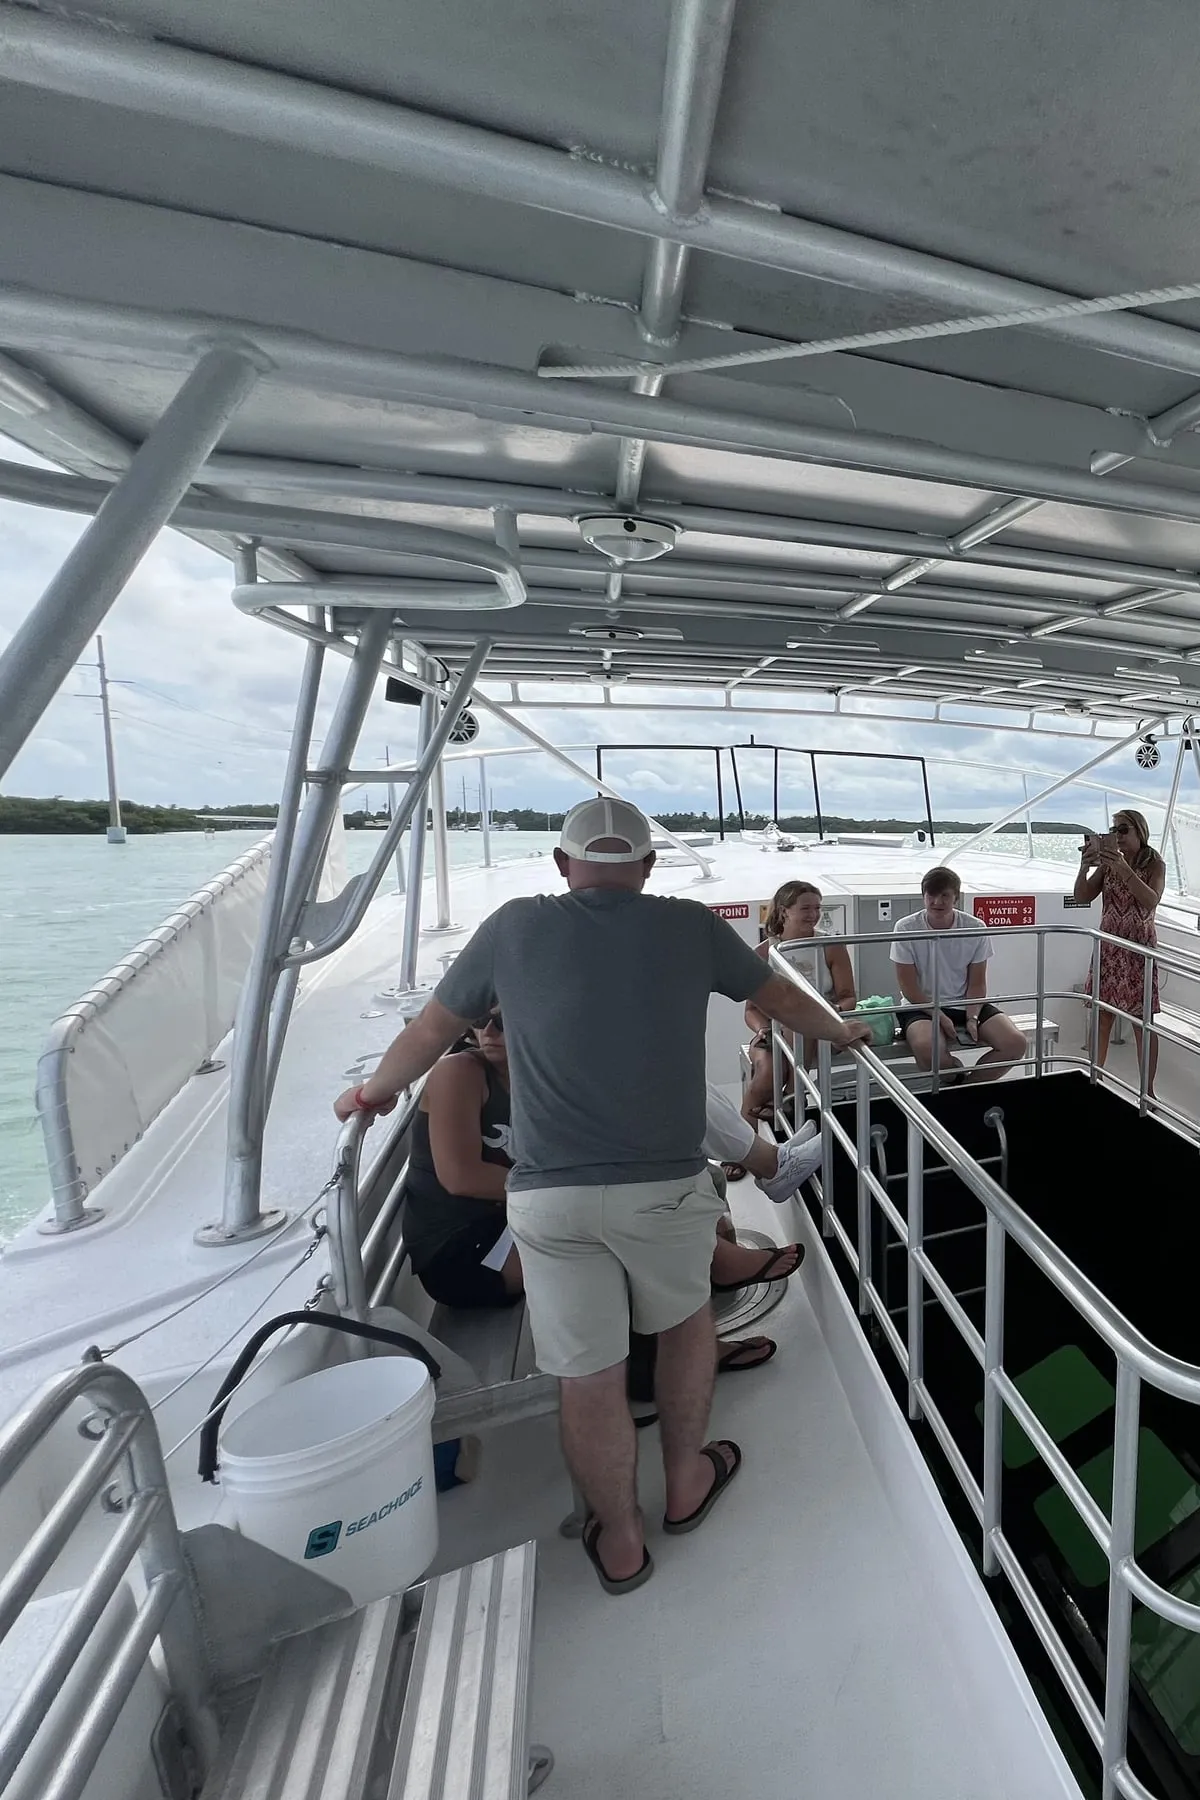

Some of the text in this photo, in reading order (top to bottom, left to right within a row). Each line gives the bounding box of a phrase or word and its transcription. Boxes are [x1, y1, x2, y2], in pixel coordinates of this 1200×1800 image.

[720, 906, 747, 917] POINT
[989, 906, 1032, 915] WATER $2
[988, 916, 1032, 925] SODA $3
[345, 1476, 423, 1537] SEACHOICE
